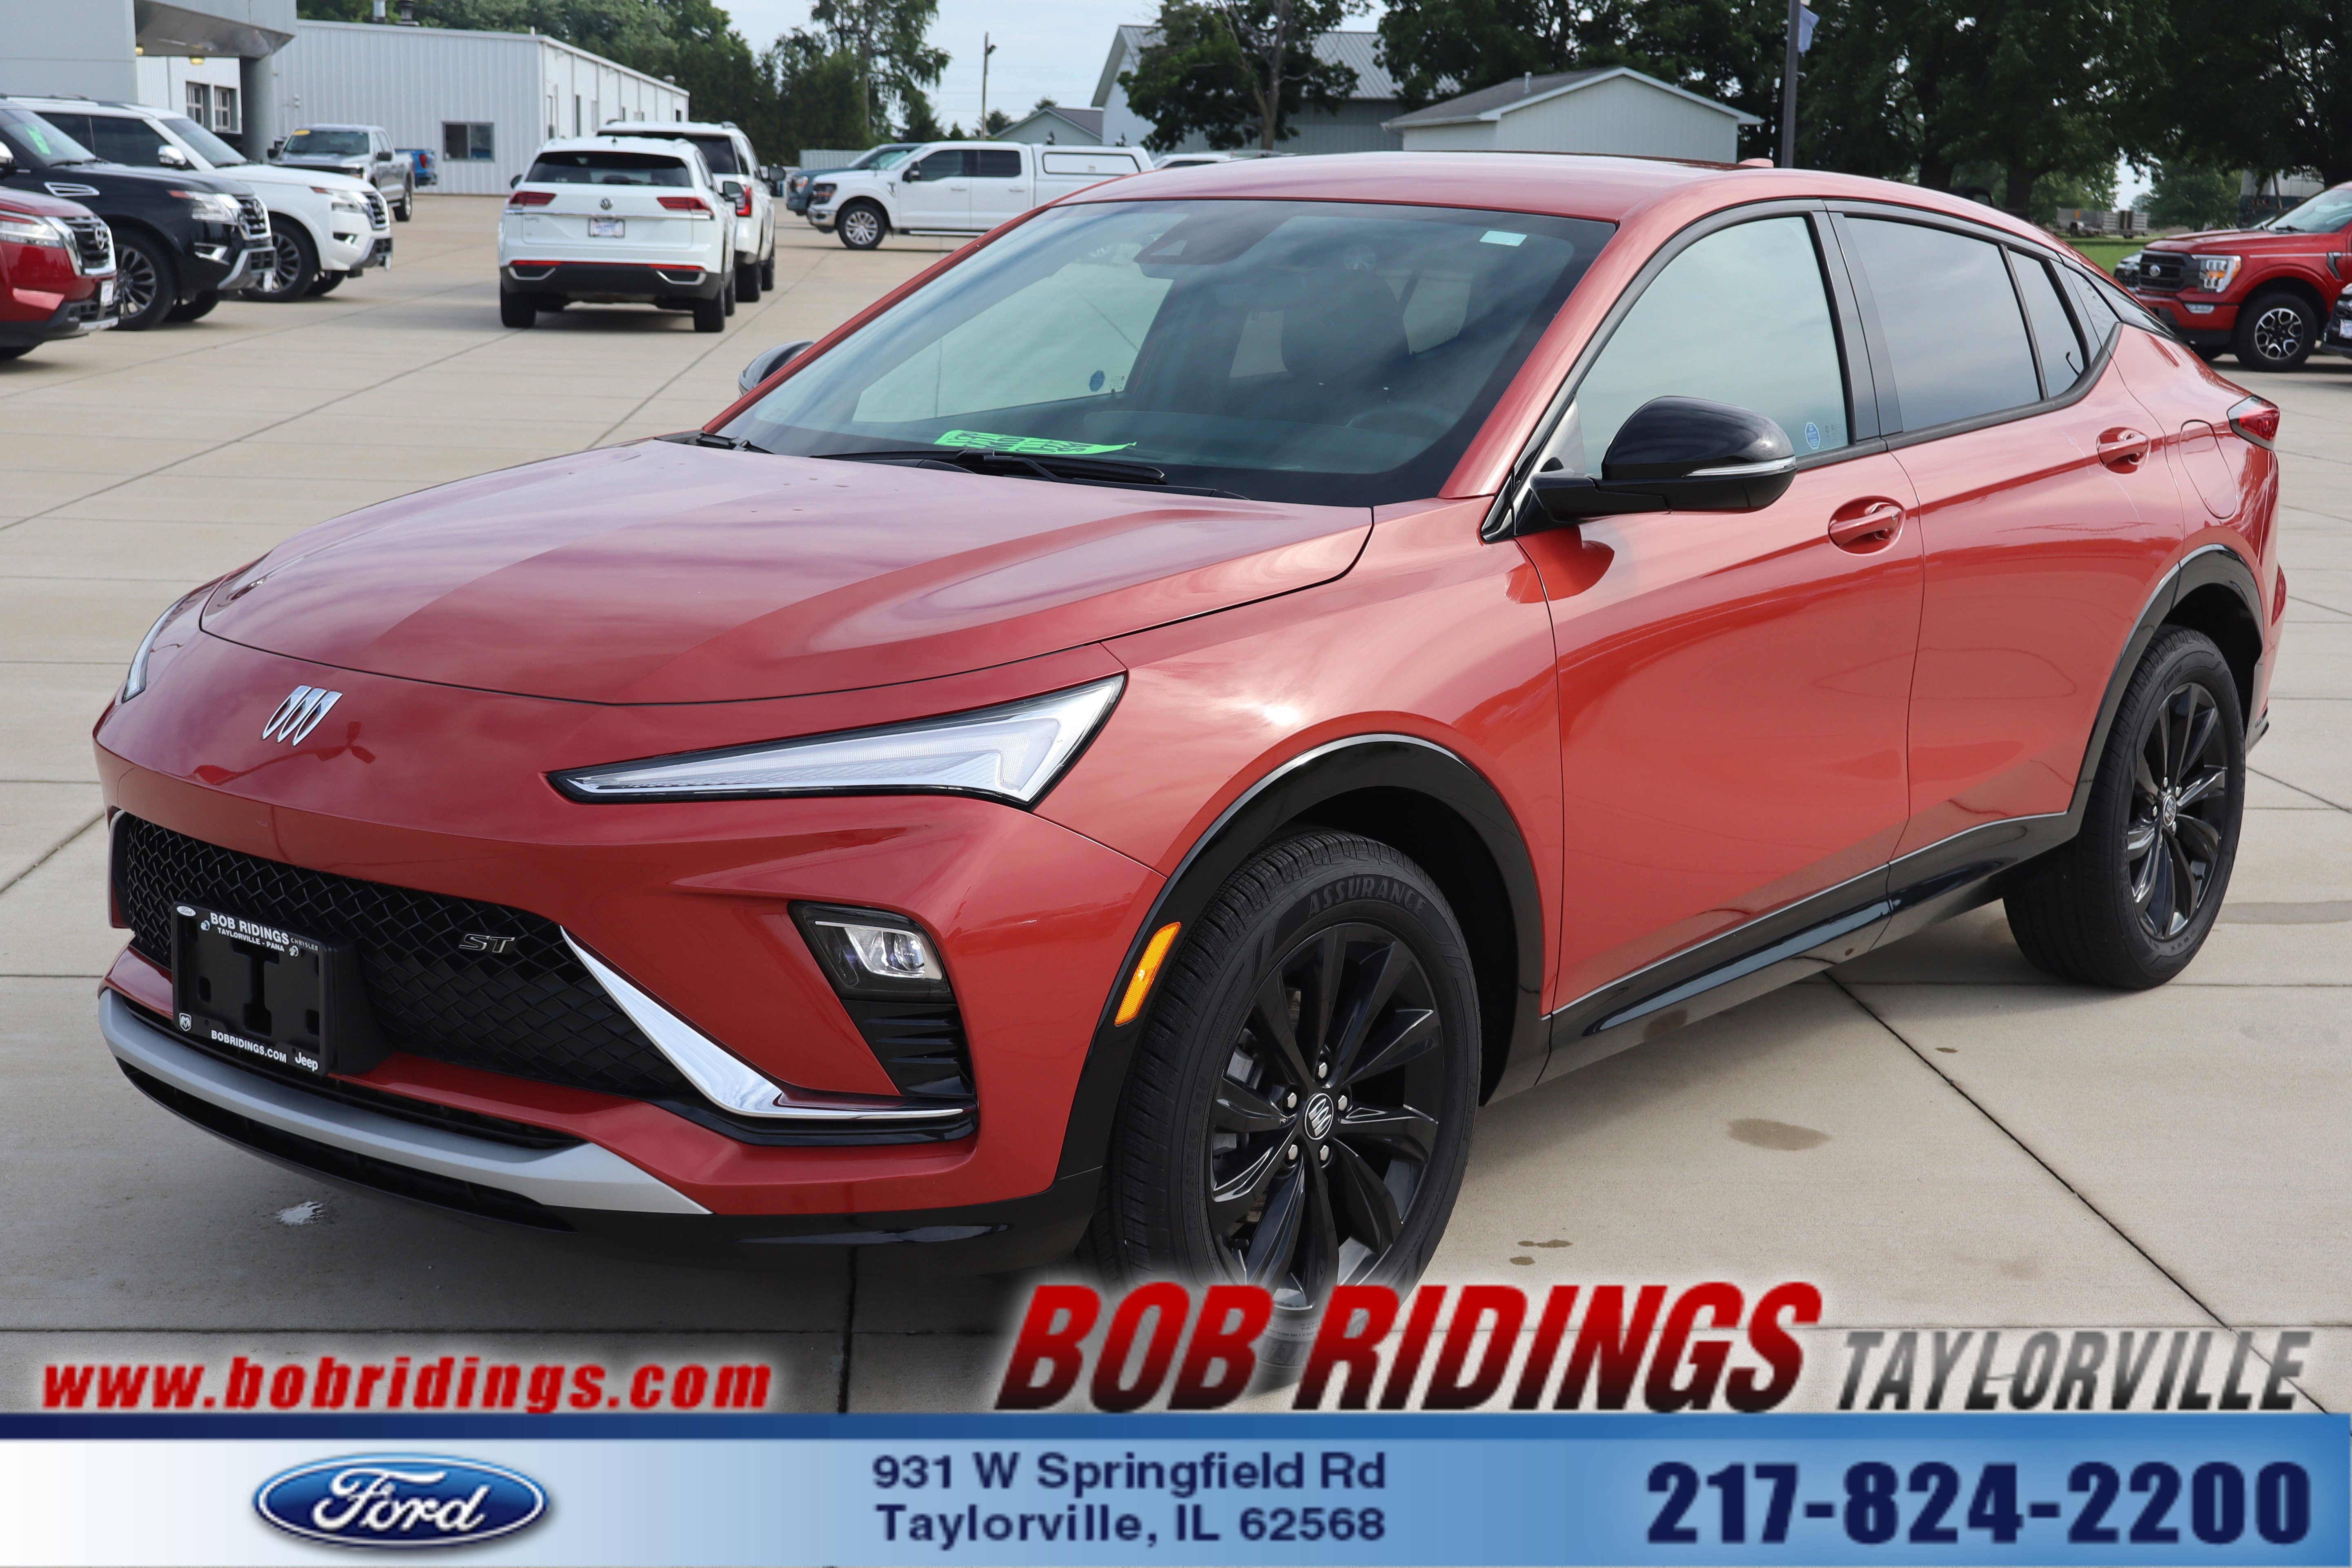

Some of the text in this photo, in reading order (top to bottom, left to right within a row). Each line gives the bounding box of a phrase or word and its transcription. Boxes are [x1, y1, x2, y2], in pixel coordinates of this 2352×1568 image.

[1308, 877, 1427, 918] ASSURANCE
[210, 912, 290, 945] BOB RIDINGS
[217, 927, 261, 945] TAYLORVILLE
[266, 942, 285, 952] PANA
[291, 938, 318, 952] CHRYSLER
[459, 933, 515, 953] ST
[212, 1030, 287, 1063] BOBRIDINGS.COM
[295, 1052, 318, 1072] Jeep
